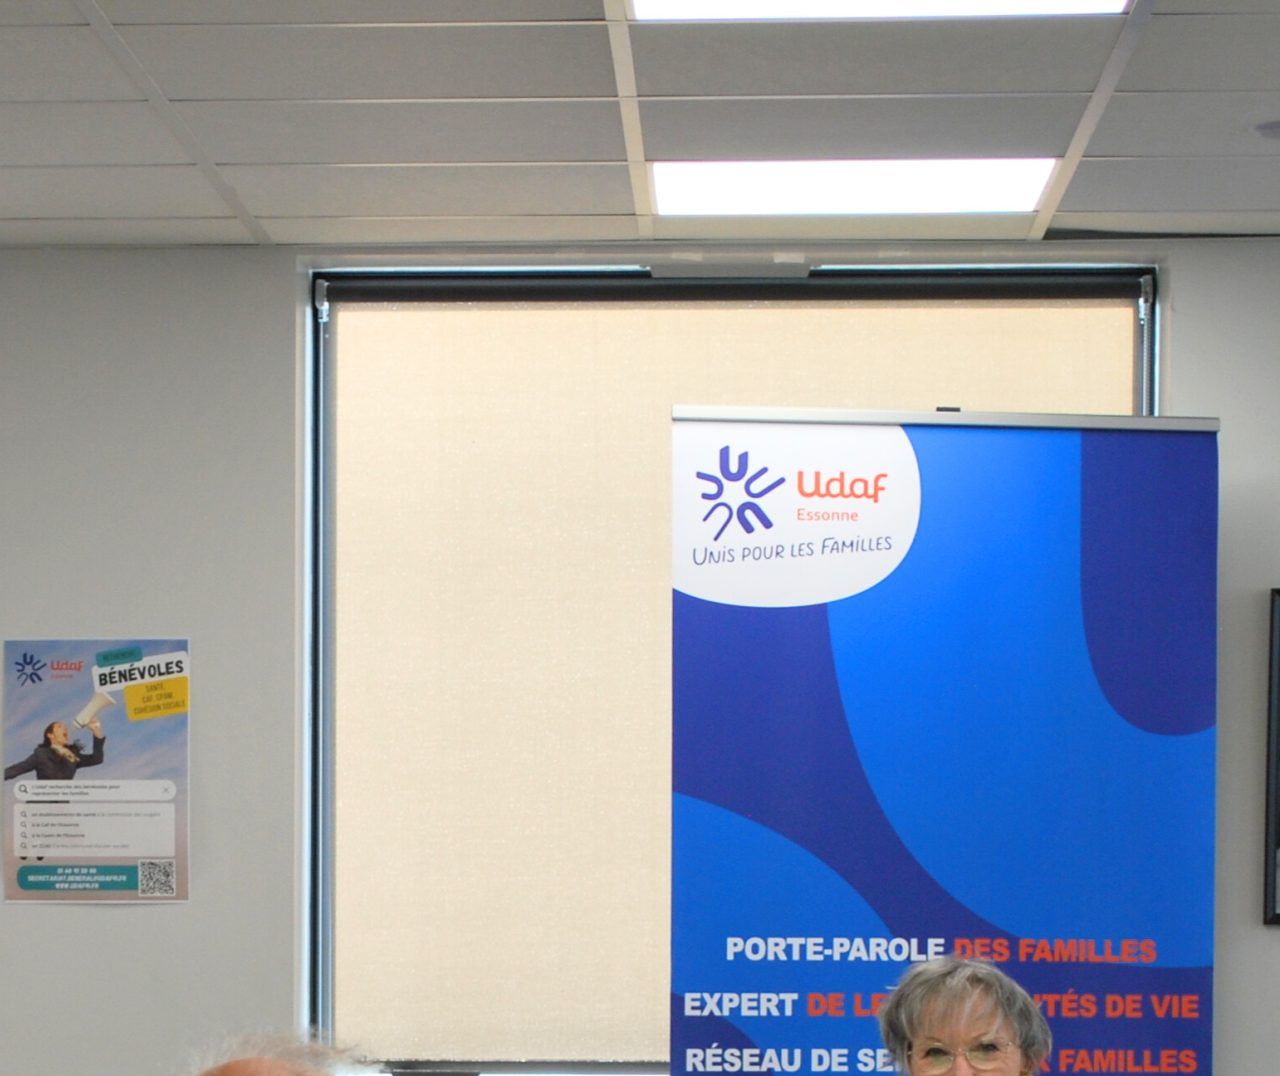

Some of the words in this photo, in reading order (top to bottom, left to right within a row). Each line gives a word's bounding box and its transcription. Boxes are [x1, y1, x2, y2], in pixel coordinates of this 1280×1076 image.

[797, 471, 888, 503] Udaf
[797, 508, 859, 521] Essonne
[98, 660, 184, 687] BÉNÉVOLES
[726, 936, 946, 962] PORTE-PAROLE
[953, 938, 1011, 962] DES
[1018, 939, 1158, 963] FAMILLES
[683, 992, 799, 1017] EXPERT
[807, 993, 846, 1017] DE
[1105, 994, 1143, 1018] DE
[1150, 995, 1200, 1019] VIE
[686, 1043, 802, 1072] RÉSEAU
[811, 1048, 849, 1072] DE
[1059, 1049, 1198, 1073] FAMILLES
